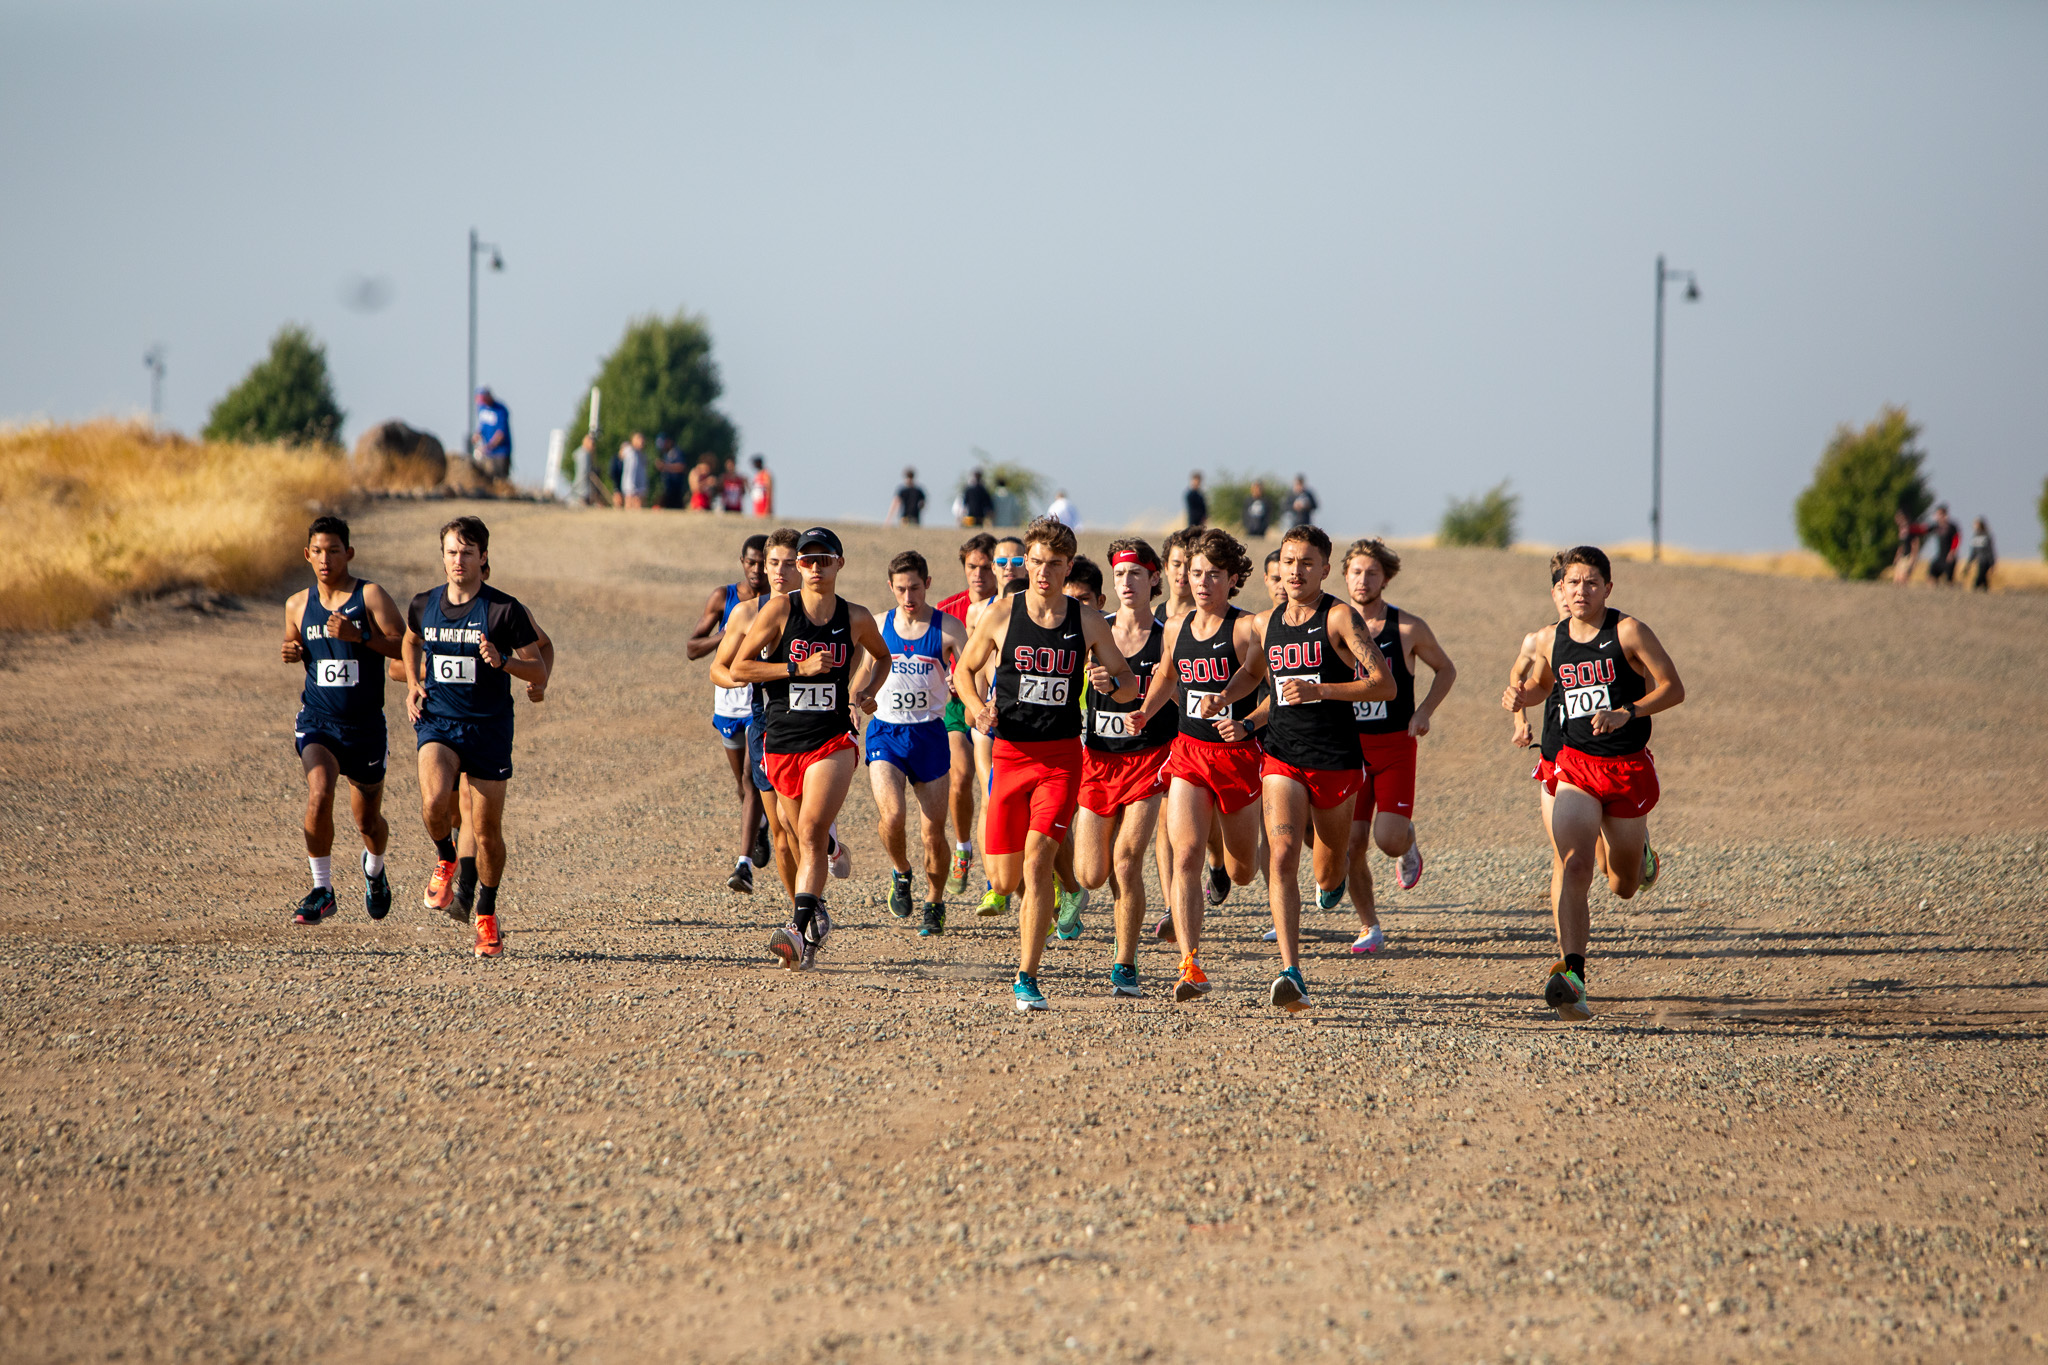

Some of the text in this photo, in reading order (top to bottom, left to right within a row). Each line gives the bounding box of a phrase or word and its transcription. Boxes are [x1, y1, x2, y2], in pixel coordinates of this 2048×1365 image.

[306, 624, 322, 641] CAL
[424, 627, 438, 642] CAL
[1015, 645, 1076, 674] SOU
[1269, 641, 1323, 671] SOU
[324, 664, 350, 683] 64
[441, 660, 467, 679] 61
[891, 661, 934, 675] ESSUP
[1178, 657, 1231, 683] SOU
[1559, 658, 1617, 688] SOU
[793, 688, 833, 707] 715
[1022, 678, 1066, 702] 716
[892, 691, 928, 710] 393
[1568, 690, 1608, 714] 702
[1099, 713, 1129, 734] 70
